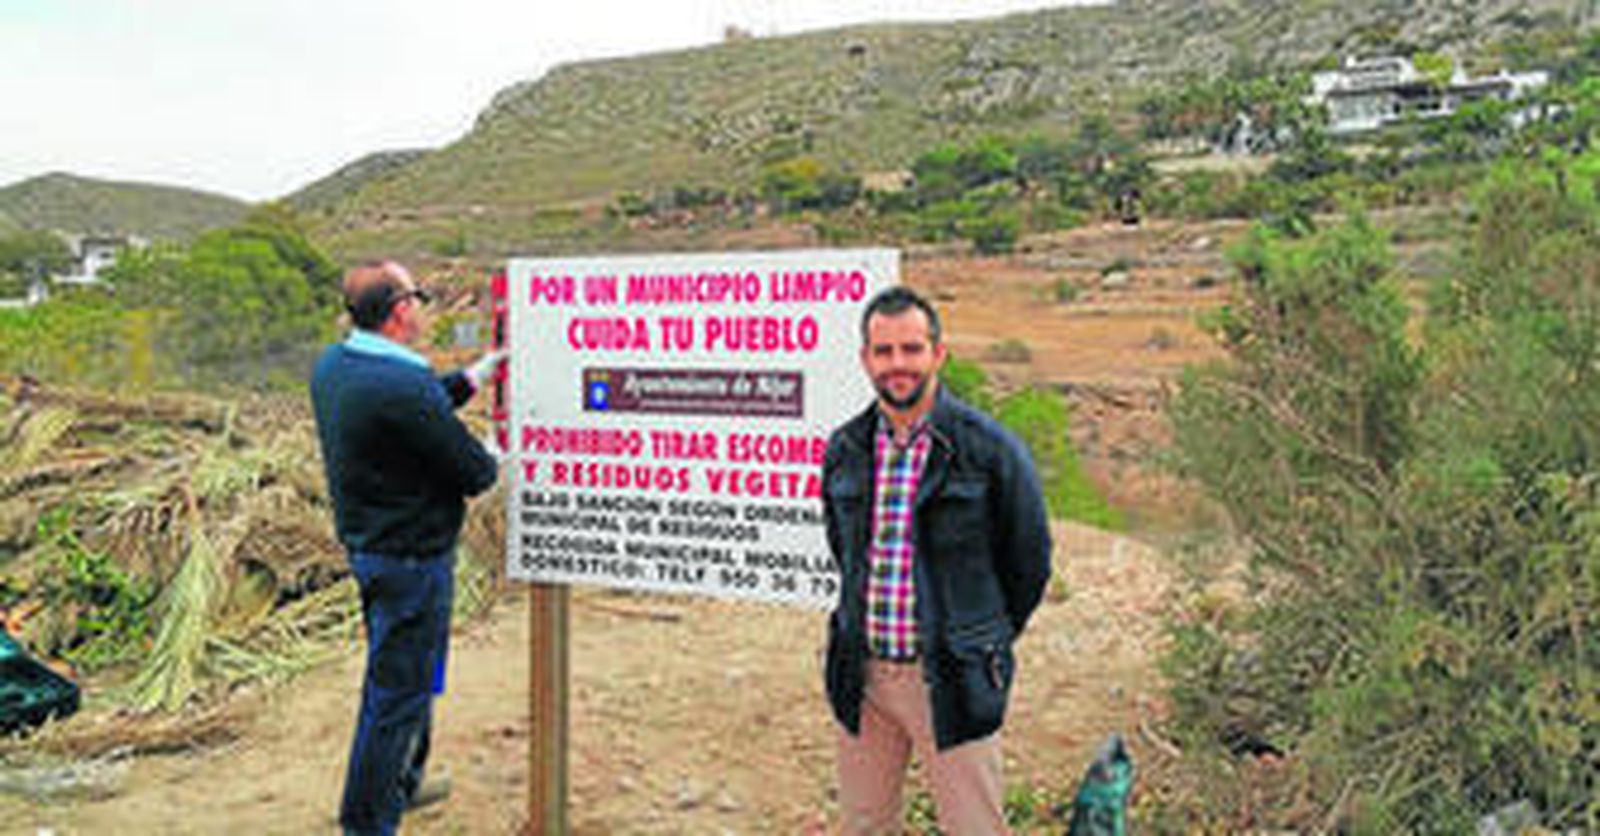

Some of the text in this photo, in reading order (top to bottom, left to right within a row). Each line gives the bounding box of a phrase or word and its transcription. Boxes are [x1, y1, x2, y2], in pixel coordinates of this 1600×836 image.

[530, 271, 867, 305] POR UN MUNICIPIO LIMPIO
[567, 315, 820, 351] CUIDA TU PUEBLO
[732, 374, 751, 396] de
[521, 426, 643, 457] PROHIBIDO
[650, 431, 718, 461] TIRAR
[521, 461, 537, 483] Y
[552, 462, 690, 490] RESIDUOS
[521, 490, 568, 508] BAJO
[521, 511, 760, 541] MUNICIPAL DE RESIDUOS
[521, 534, 618, 555] RECOGIDA
[625, 541, 736, 566] MUNICIPAL
[720, 568, 760, 589] 950
